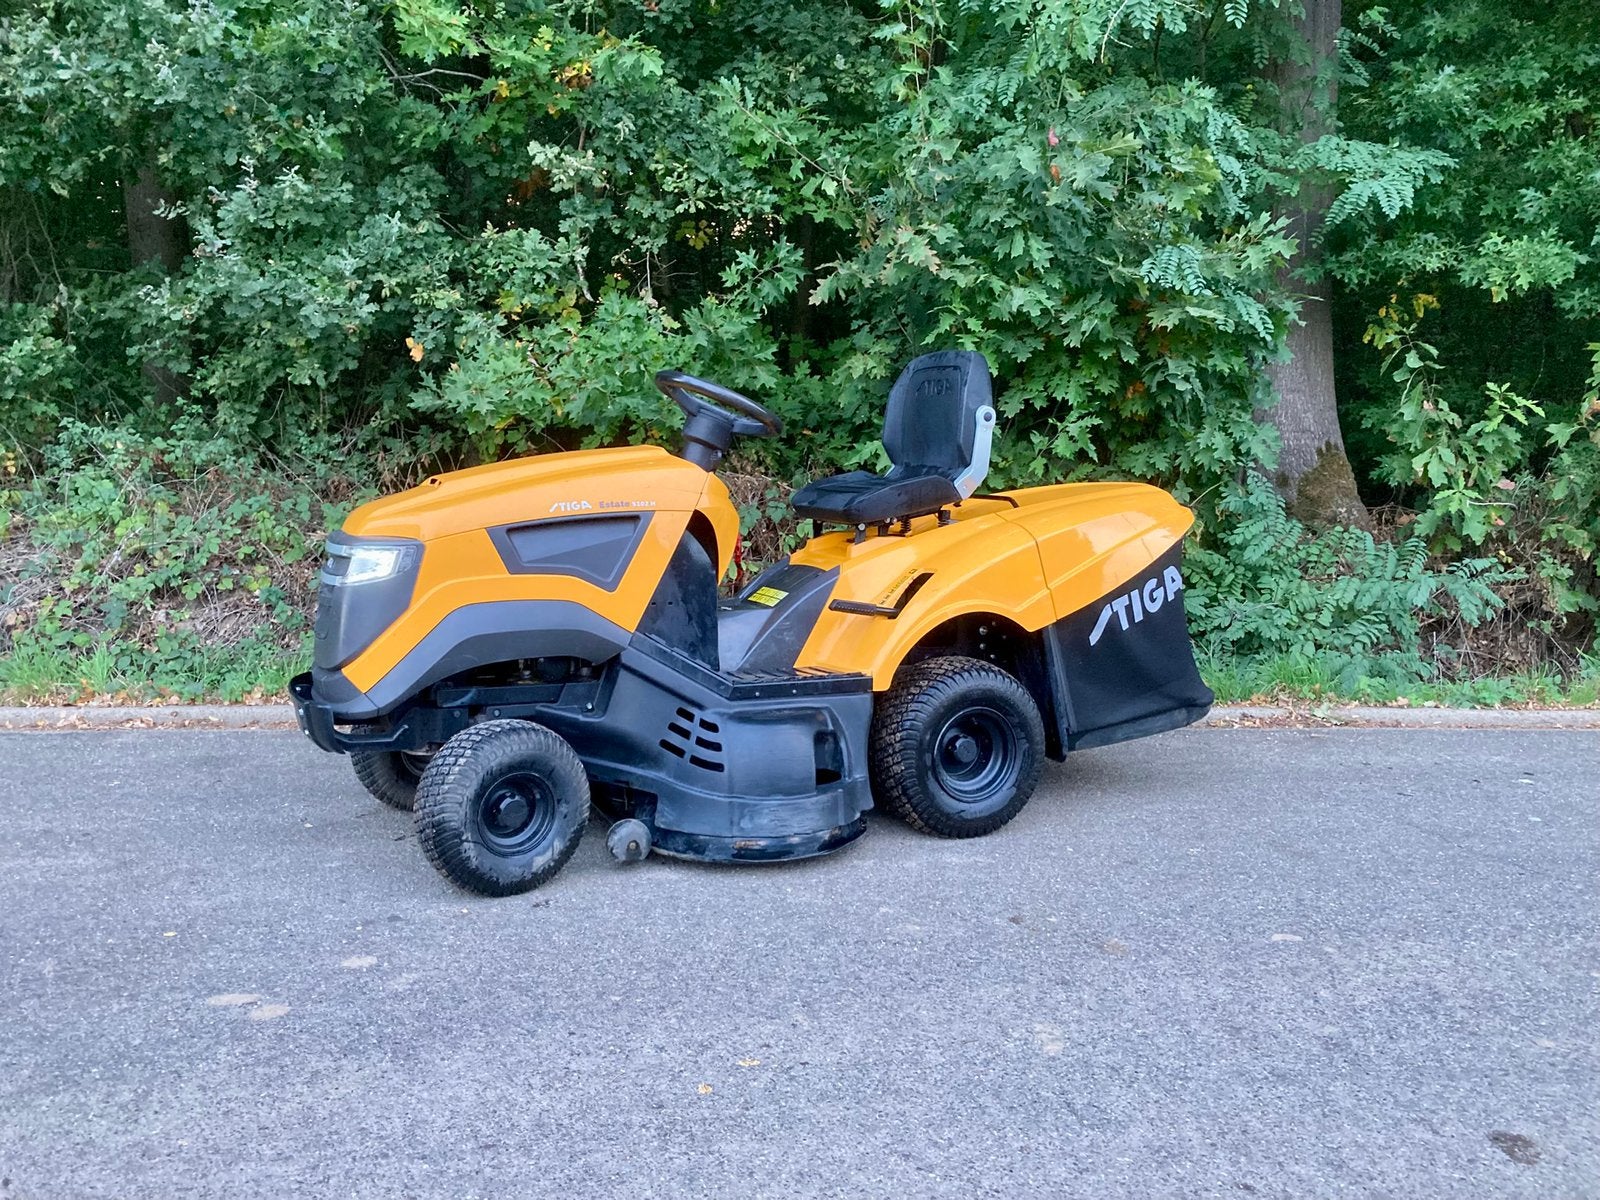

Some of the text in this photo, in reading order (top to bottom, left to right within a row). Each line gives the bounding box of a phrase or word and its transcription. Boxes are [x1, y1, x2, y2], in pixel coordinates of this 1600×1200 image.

[915, 379, 953, 396] STIGA
[549, 500, 592, 512] STIGA
[599, 500, 630, 508] Estate
[1088, 565, 1183, 647] STIGA
